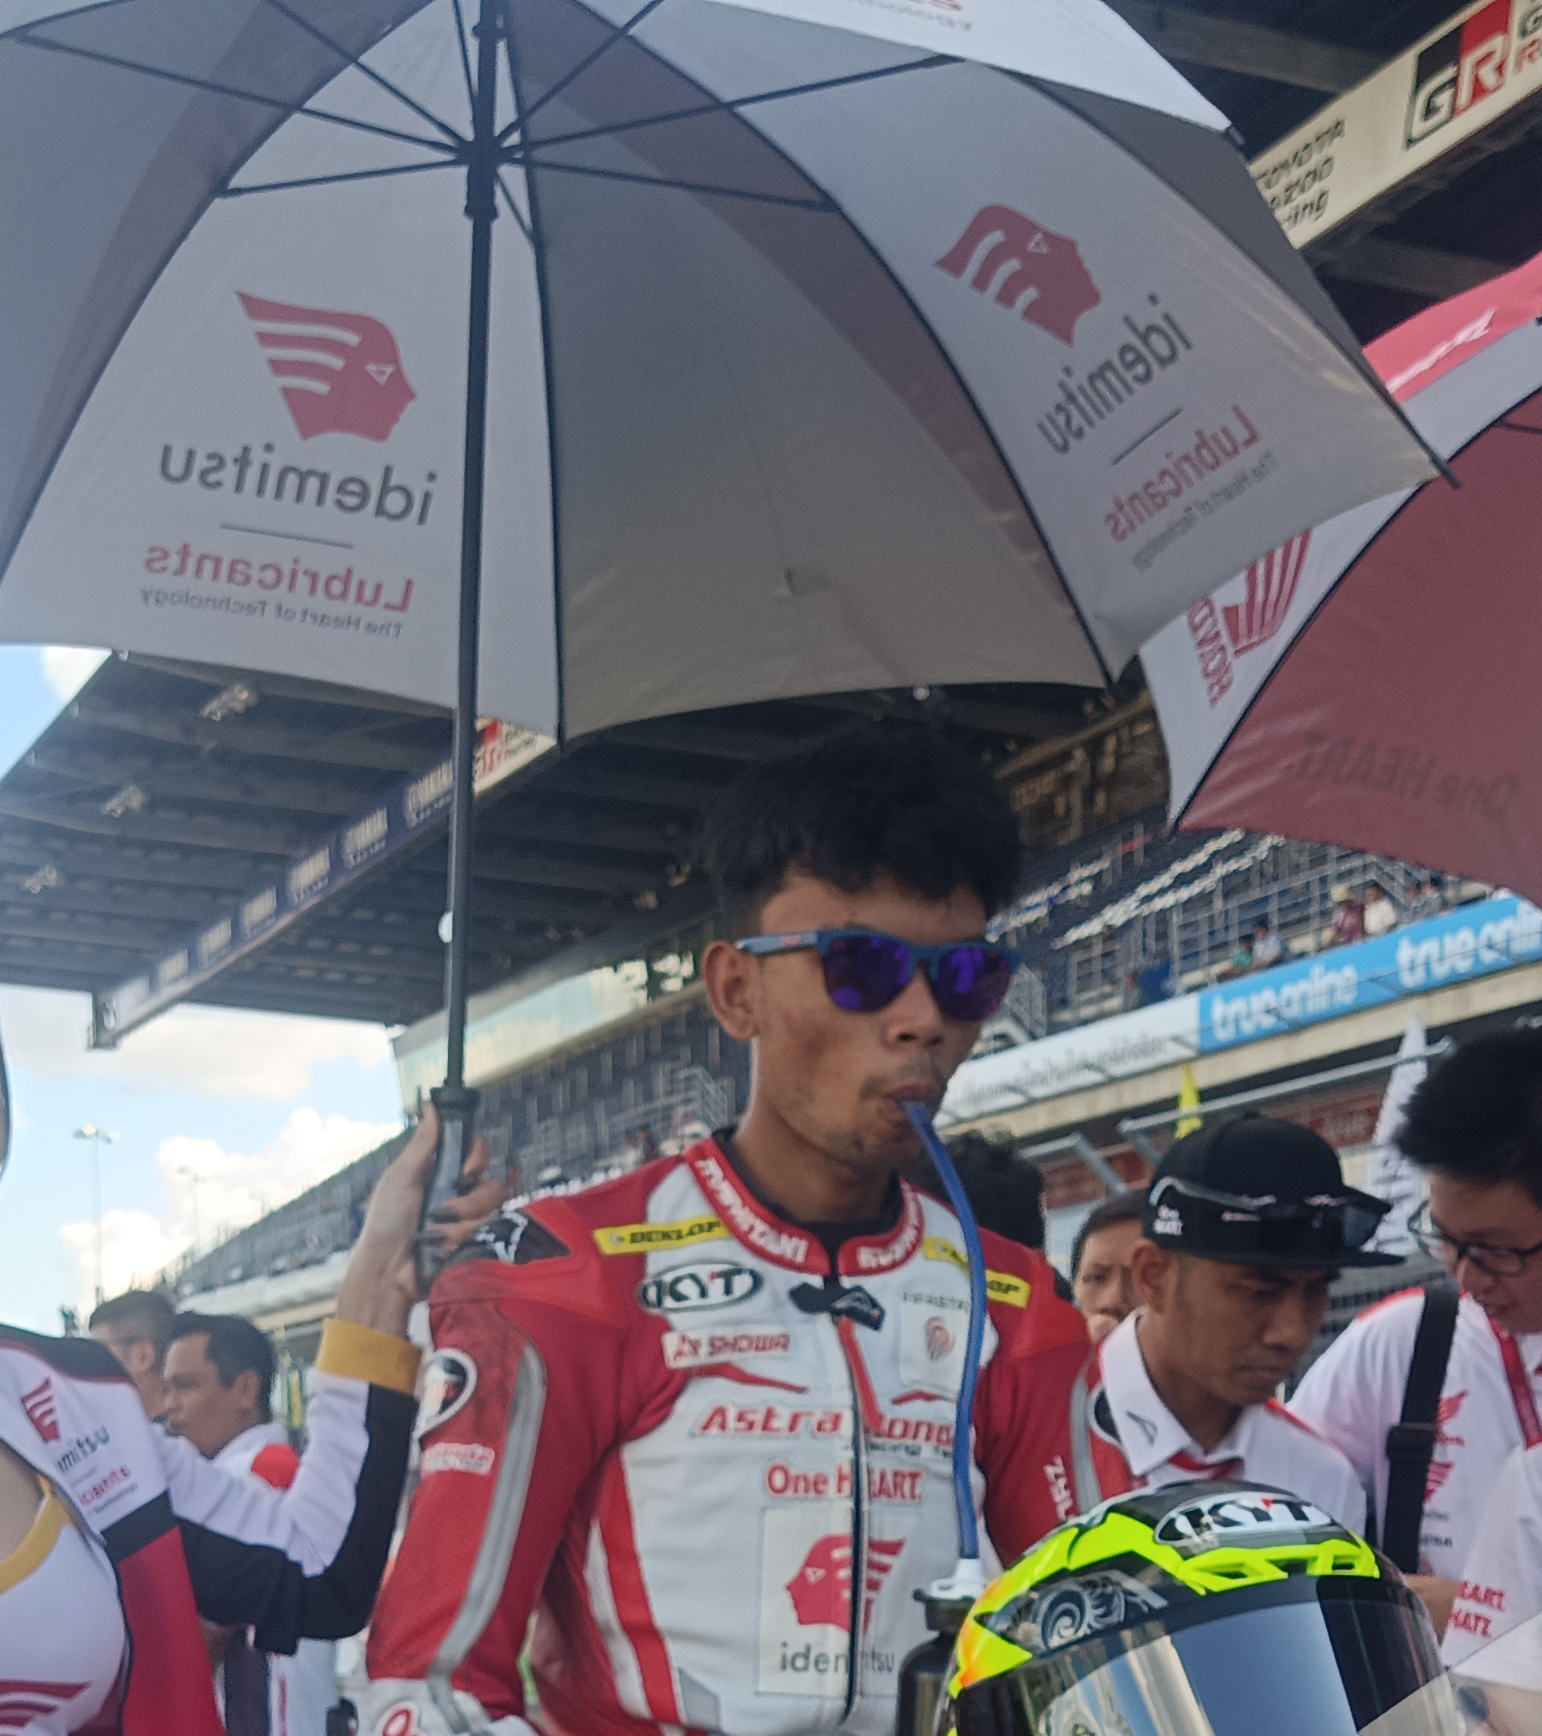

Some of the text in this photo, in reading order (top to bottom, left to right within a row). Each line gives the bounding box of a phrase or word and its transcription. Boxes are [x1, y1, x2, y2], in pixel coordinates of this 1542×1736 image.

[699, 1405, 843, 1435] Astra
[766, 1462, 829, 1497] One
[1159, 1498, 1315, 1542] KYT
